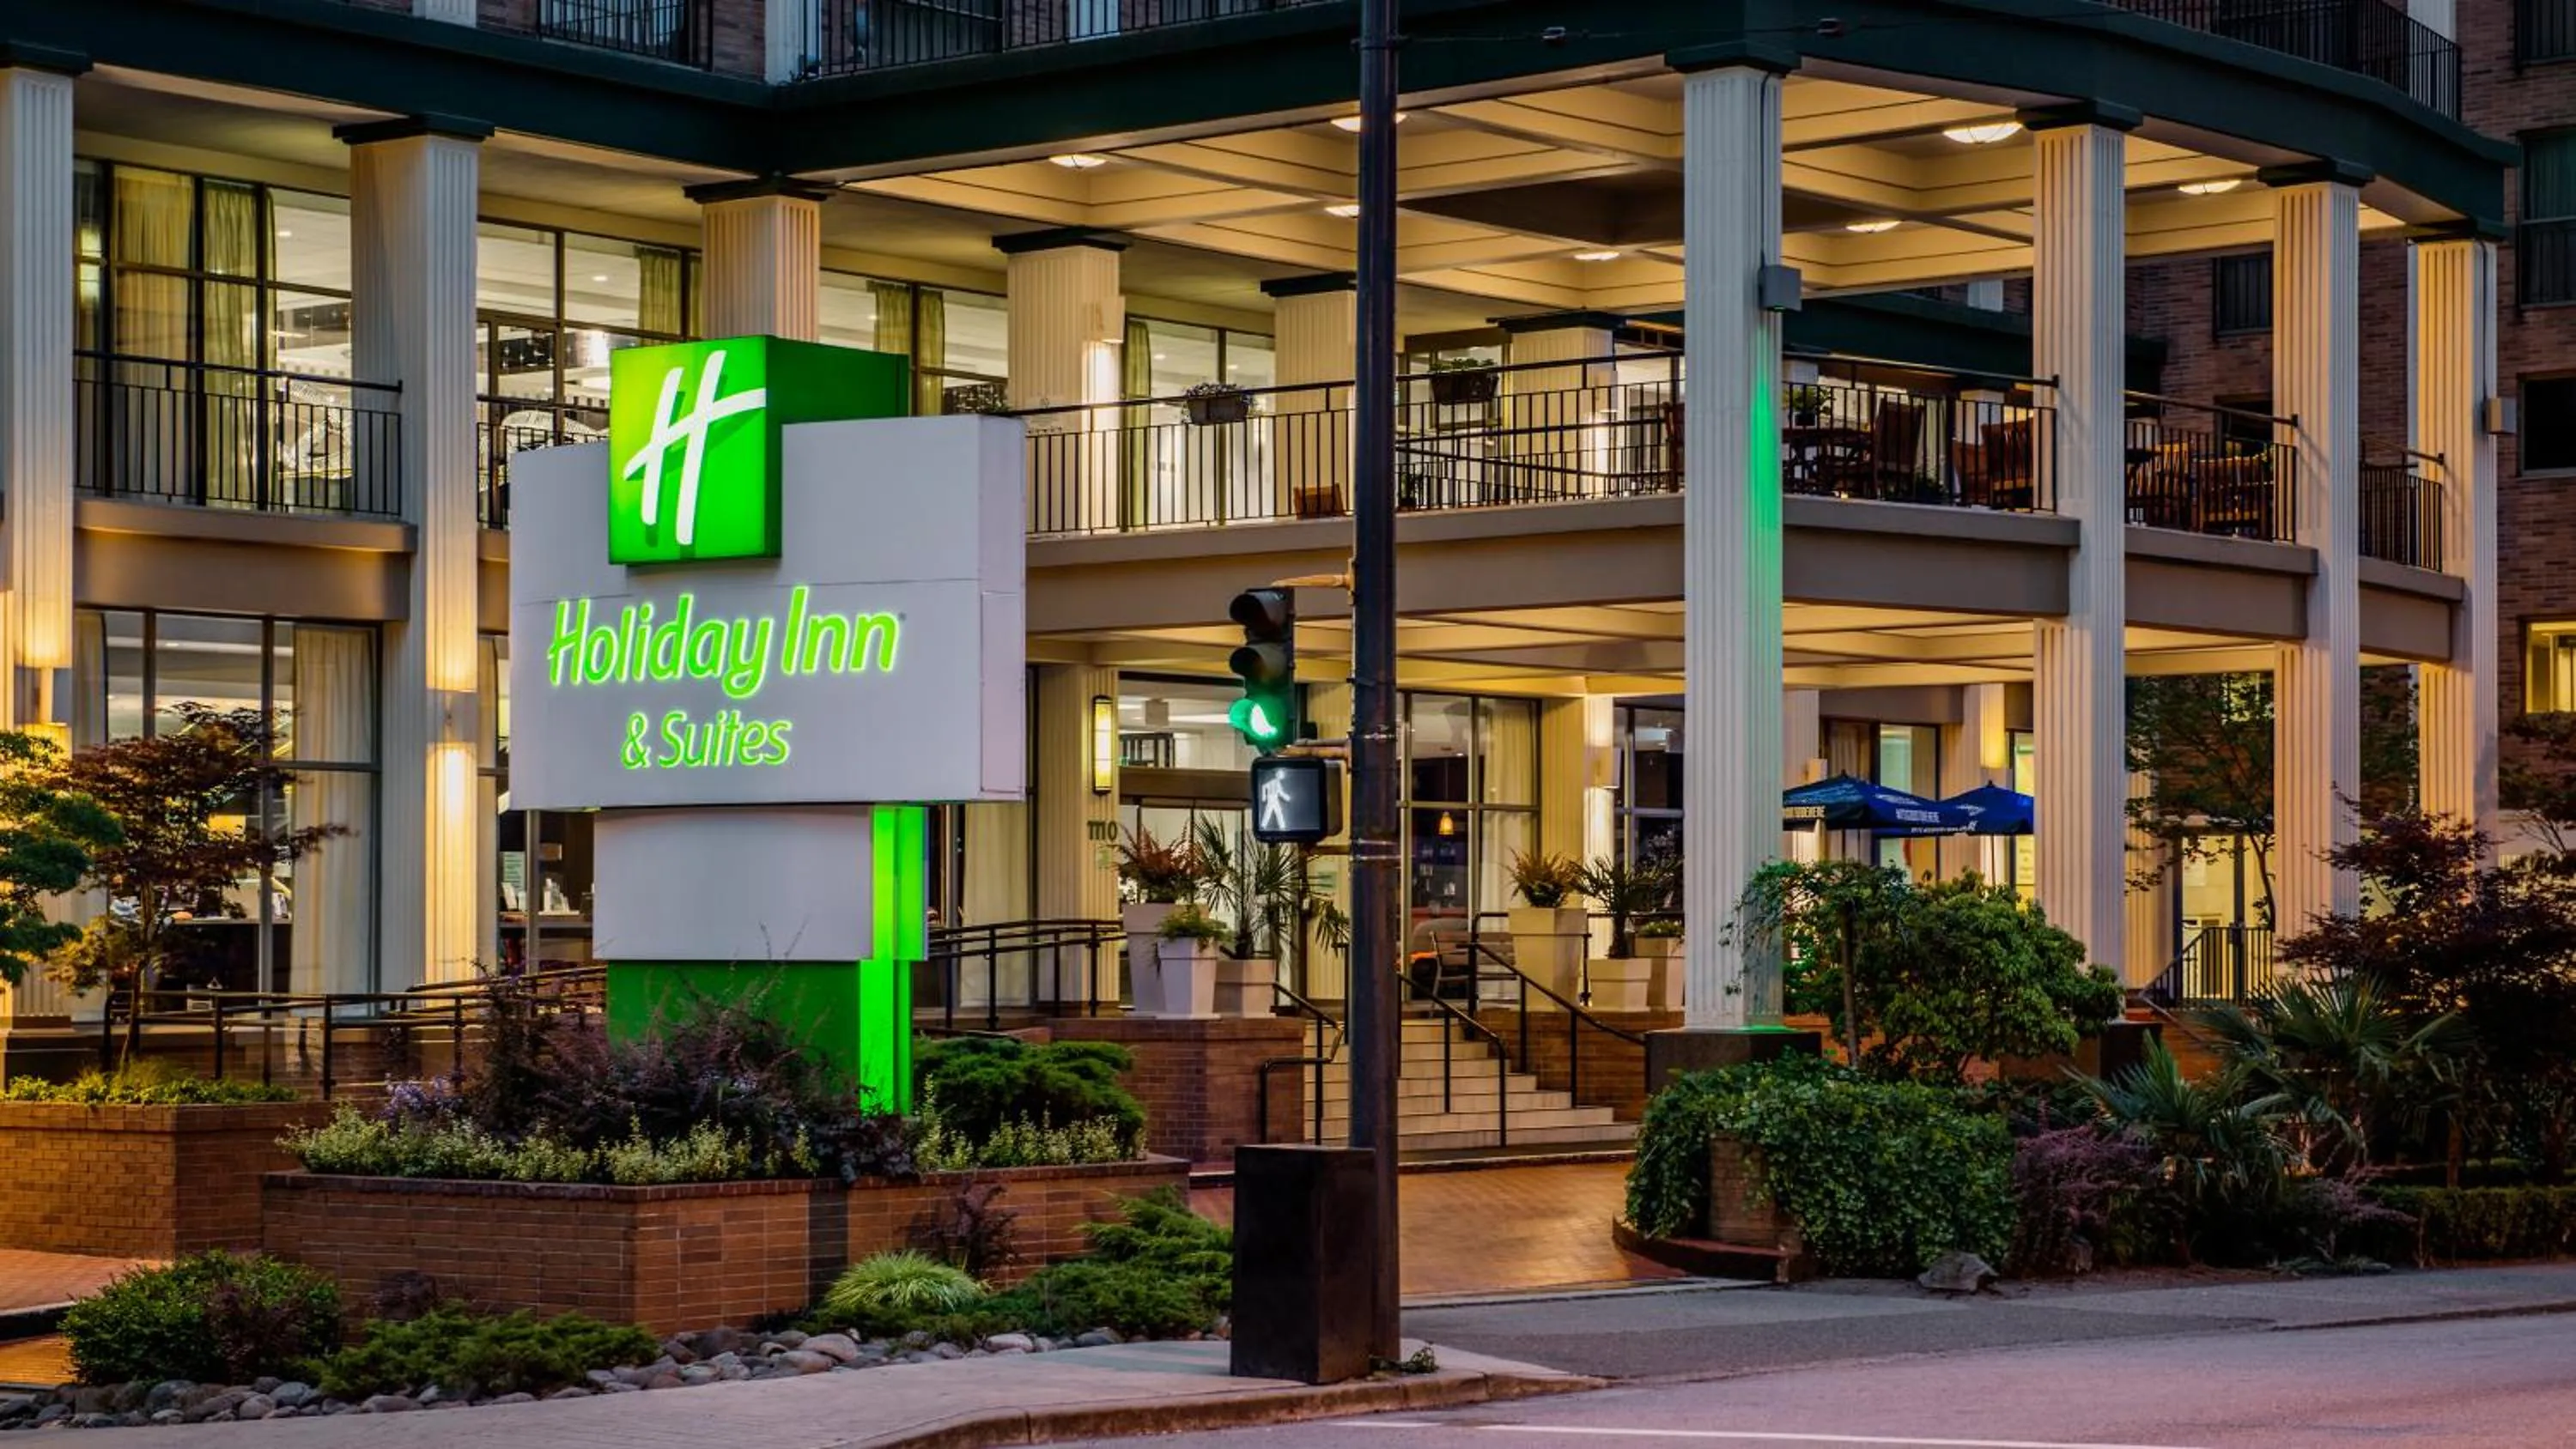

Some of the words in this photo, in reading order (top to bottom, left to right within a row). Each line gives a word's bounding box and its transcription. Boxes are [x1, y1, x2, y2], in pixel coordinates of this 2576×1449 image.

[623, 349, 767, 546] H
[547, 592, 775, 700] Holiday
[781, 585, 899, 676] Inn
[621, 712, 652, 769] &
[659, 710, 793, 767] Suites
[1087, 820, 1118, 842] 1110
